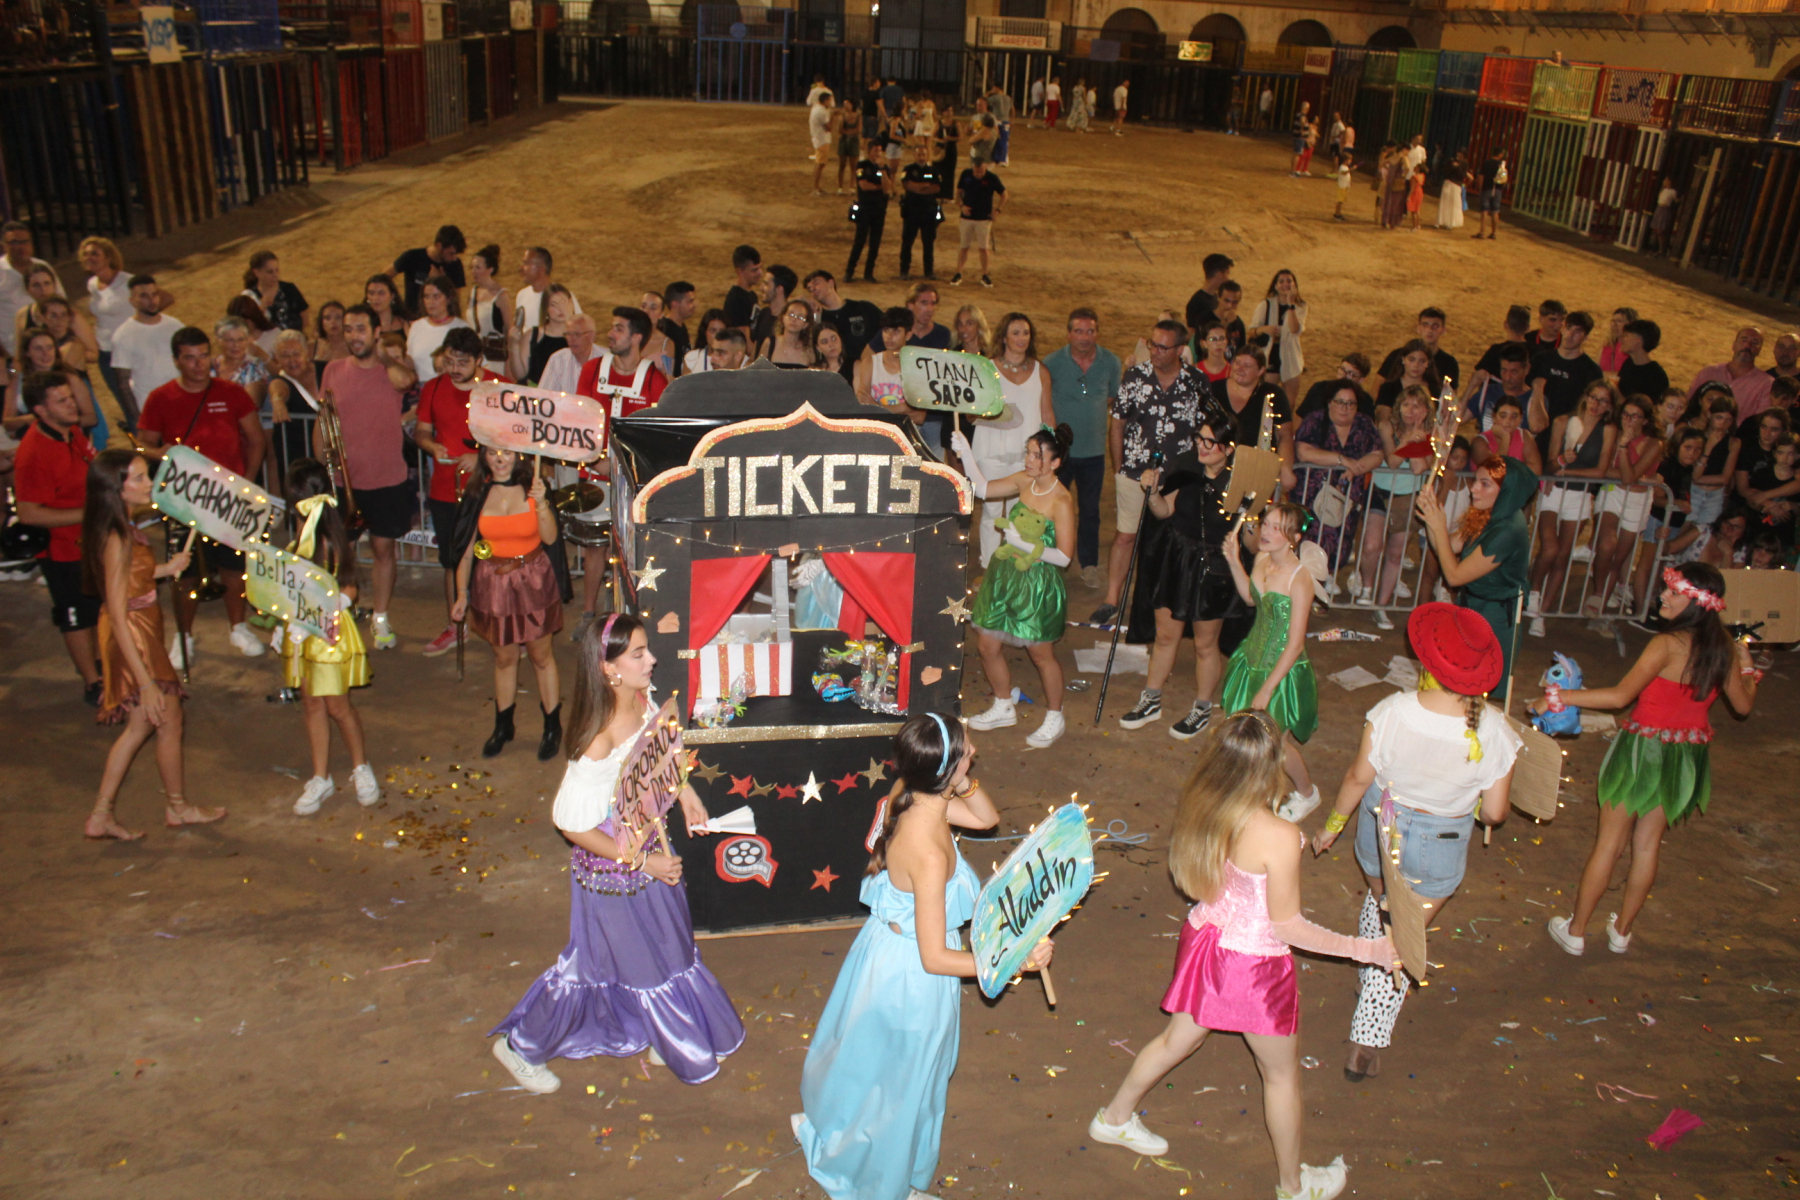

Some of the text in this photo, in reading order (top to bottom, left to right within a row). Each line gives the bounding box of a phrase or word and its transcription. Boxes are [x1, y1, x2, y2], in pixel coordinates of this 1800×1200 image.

[915, 357, 985, 389] TIANA
[929, 380, 976, 407] SAPO
[486, 389, 555, 418] EL GATO
[512, 419, 596, 451] CON BOTAS
[159, 459, 266, 541] POCAHONTAS
[694, 454, 923, 517] TICKETS
[256, 550, 296, 589] Bella
[295, 592, 335, 639] Bestia
[616, 714, 678, 816] JOROBADO
[650, 754, 683, 812] DAME
[991, 847, 1077, 968] Aladdin
